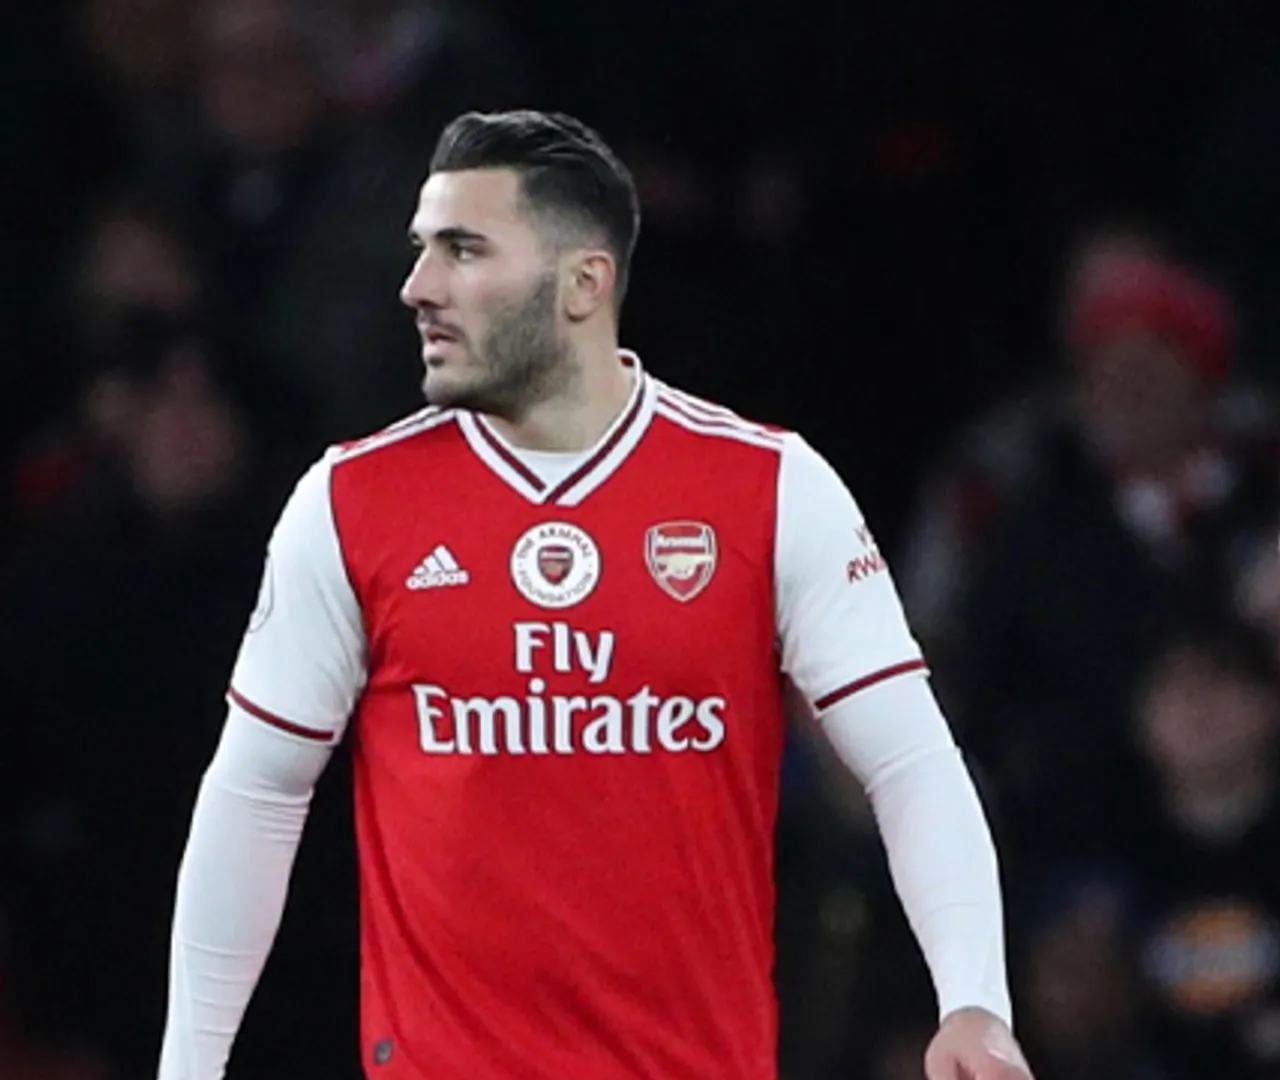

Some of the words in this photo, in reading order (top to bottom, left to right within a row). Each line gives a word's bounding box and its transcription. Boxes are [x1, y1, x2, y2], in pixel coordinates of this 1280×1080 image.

[405, 569, 469, 590] adidas
[513, 620, 614, 683] Fly
[411, 677, 726, 755] Emirates
